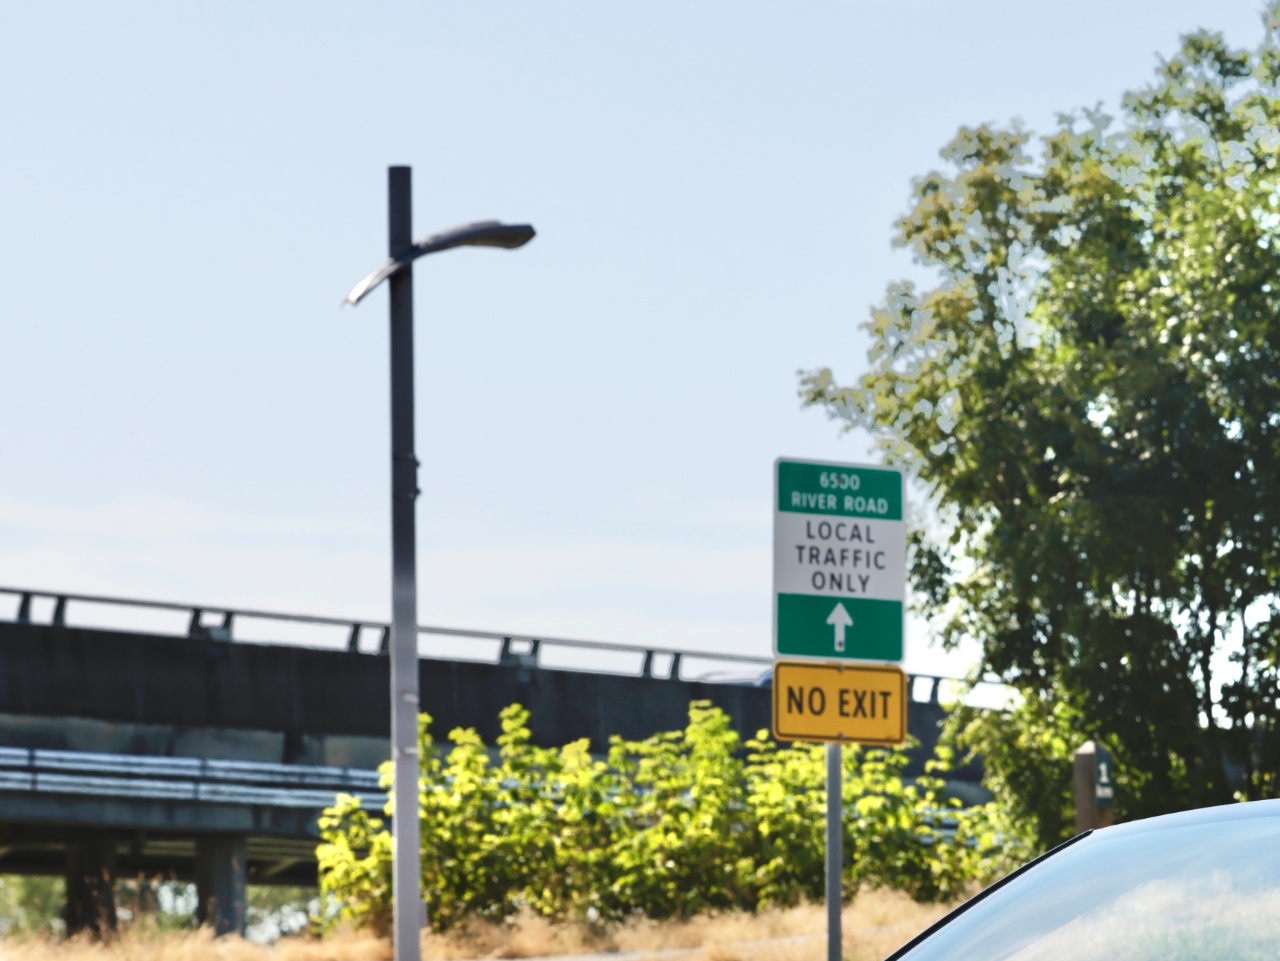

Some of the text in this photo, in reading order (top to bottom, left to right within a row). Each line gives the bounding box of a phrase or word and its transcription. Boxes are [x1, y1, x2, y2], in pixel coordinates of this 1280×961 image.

[791, 490, 888, 515] RIVER ROAD
[806, 519, 875, 544] LOCAL
[795, 544, 886, 570] TRAFFIC
[811, 570, 870, 593] ONLY
[786, 685, 892, 719] NO EXIT
[1099, 762, 1109, 783] 1
